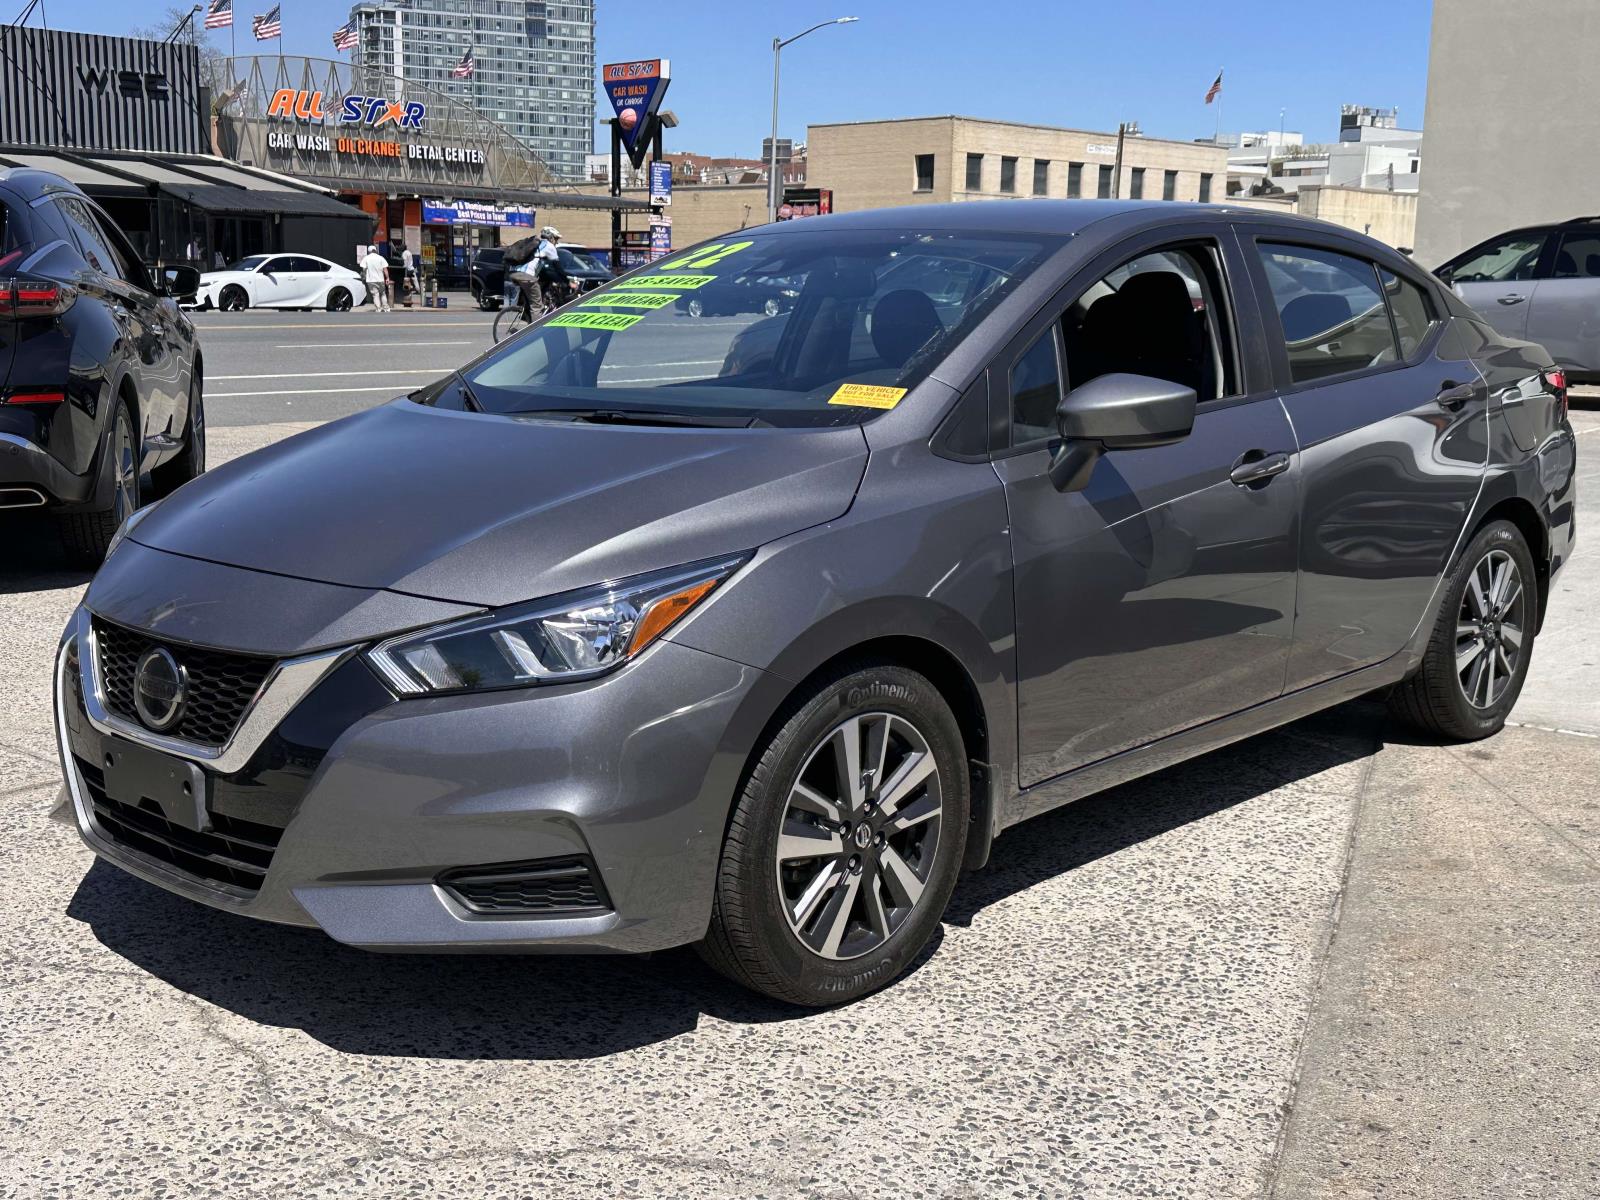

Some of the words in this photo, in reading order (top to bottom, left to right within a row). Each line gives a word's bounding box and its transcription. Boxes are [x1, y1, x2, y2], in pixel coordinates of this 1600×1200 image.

[610, 65, 625, 78] ALL
[76, 66, 169, 100] WISE
[613, 87, 626, 97] CAR
[628, 85, 648, 96] WASH
[267, 88, 324, 119] ALL
[268, 132, 292, 149] CAR
[295, 134, 330, 151] WASH
[338, 138, 356, 154] OIL
[357, 139, 401, 156] CHANGE
[408, 144, 445, 160] DETAIL
[445, 147, 484, 164] CENTER
[660, 241, 754, 270] 22
[590, 315, 640, 328] CLEAN
[865, 385, 901, 395] VEHICLE
